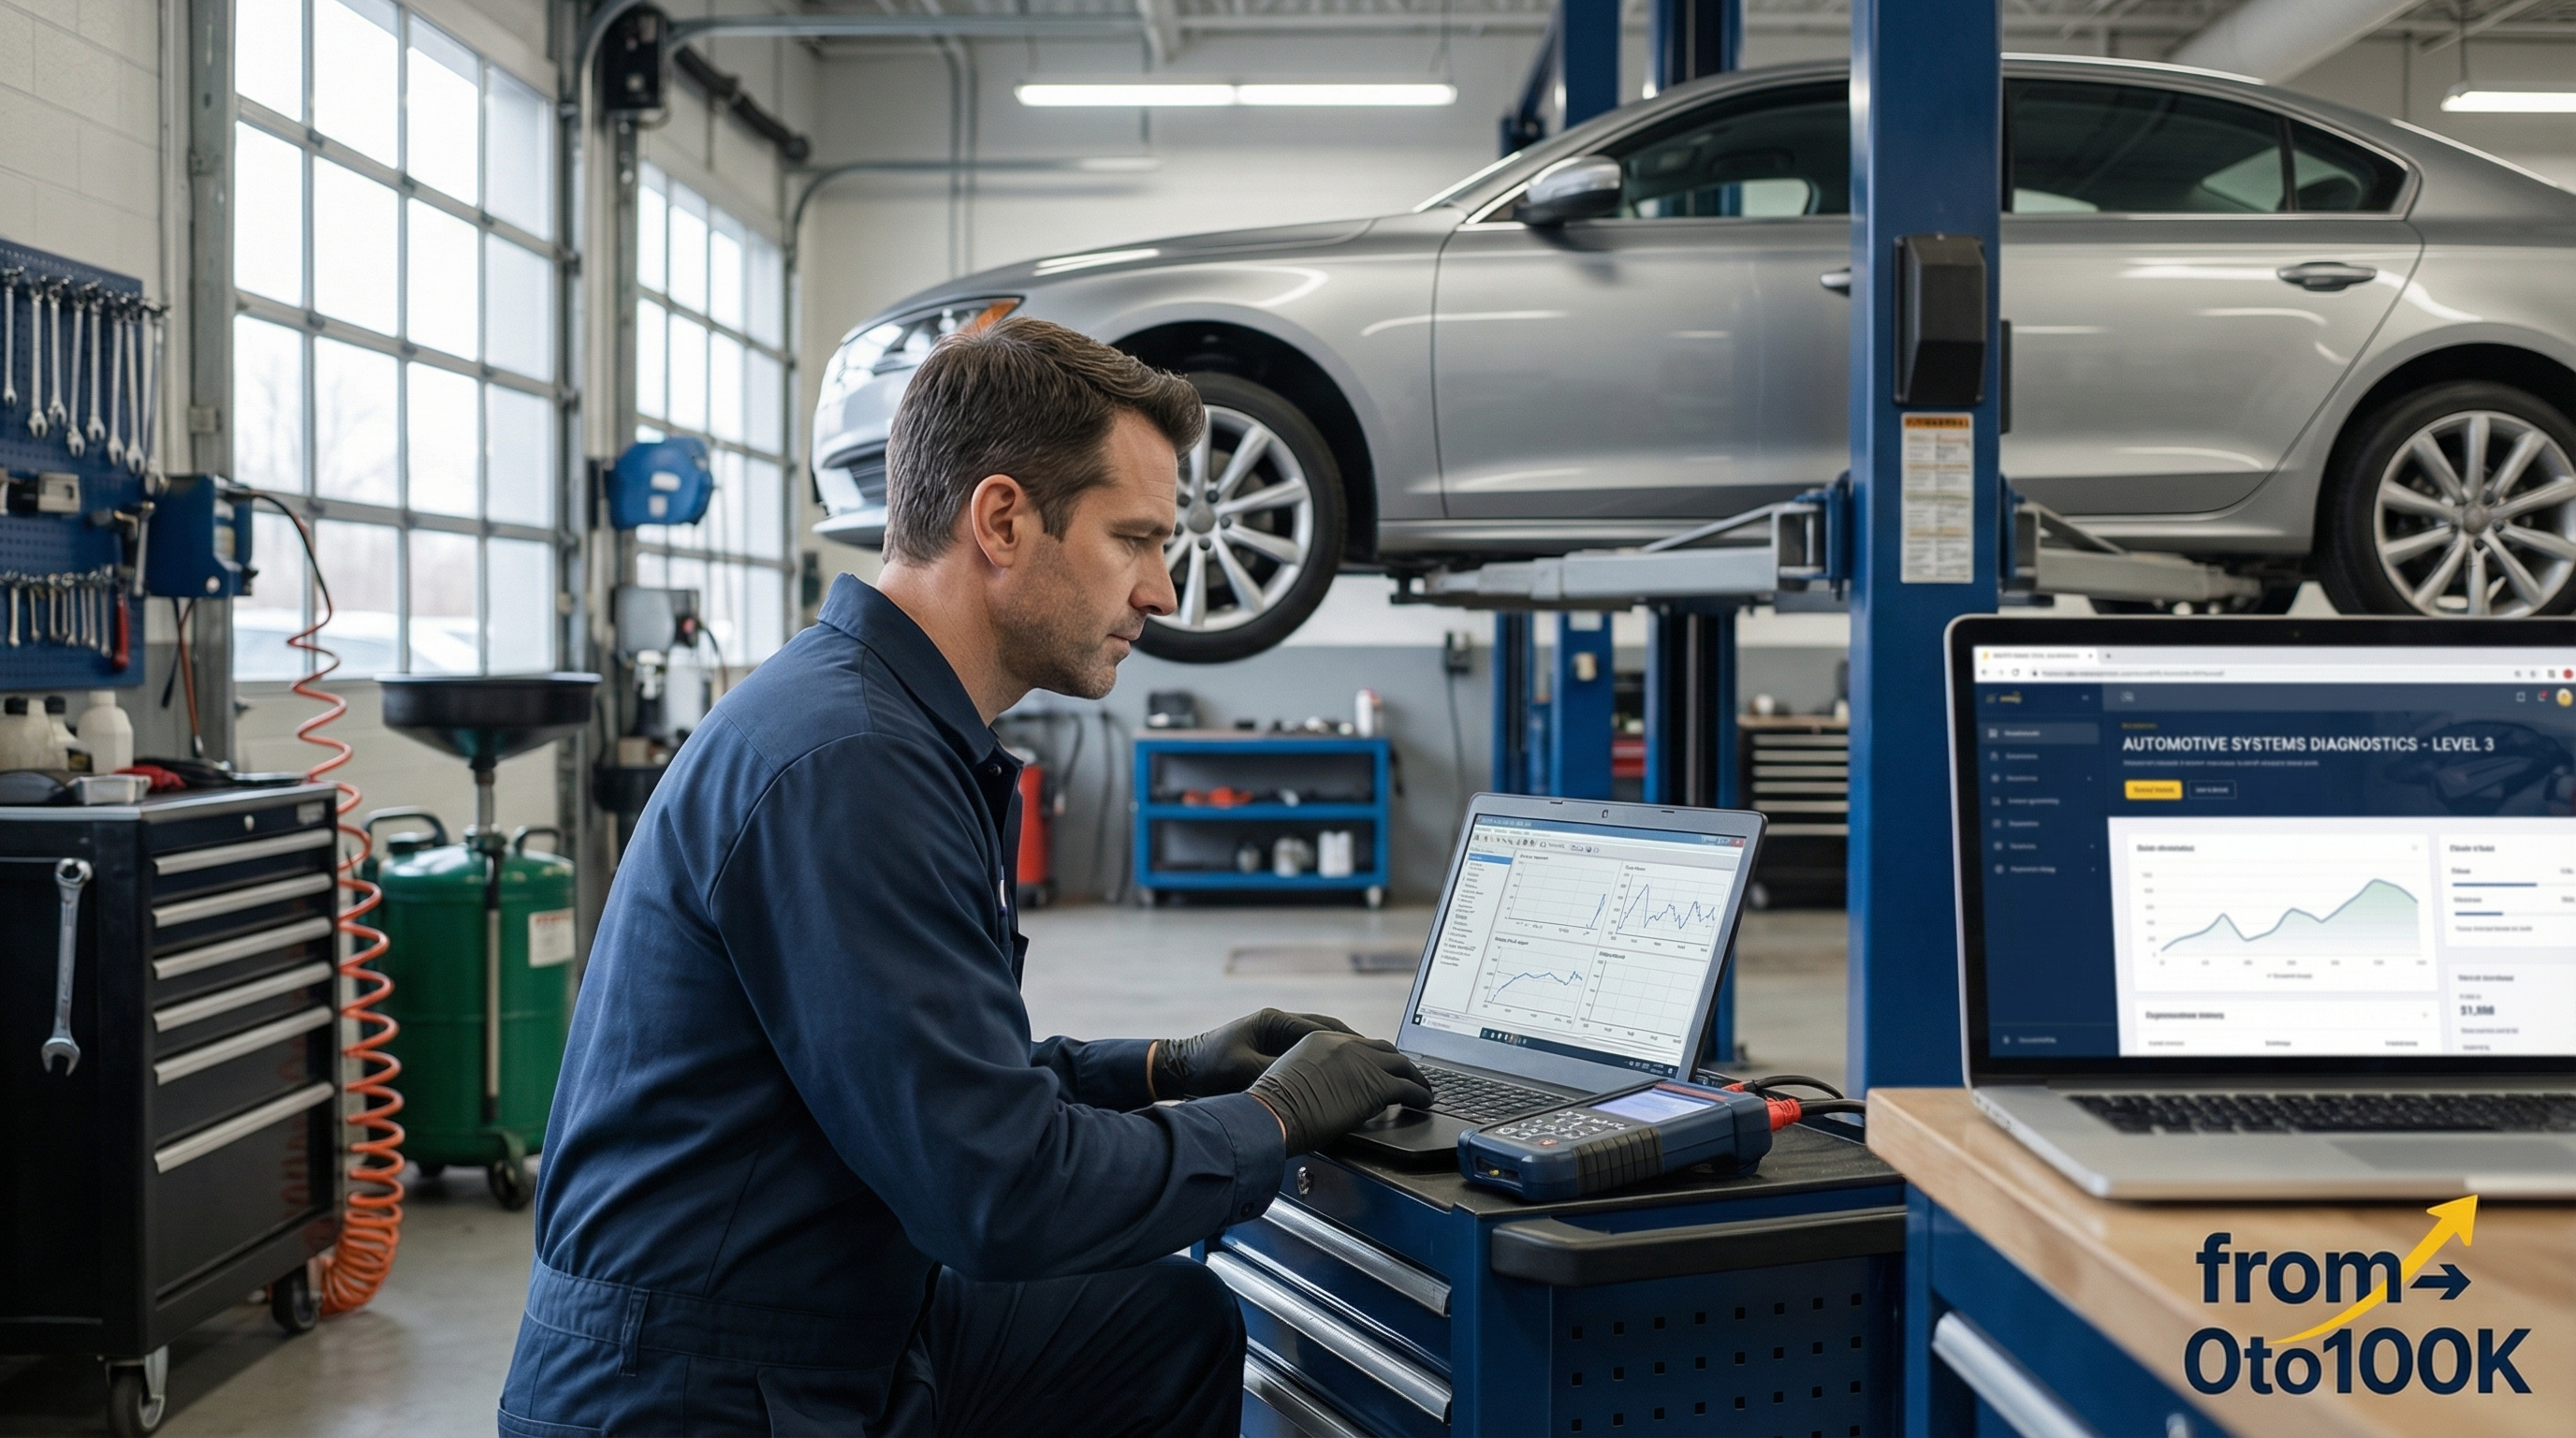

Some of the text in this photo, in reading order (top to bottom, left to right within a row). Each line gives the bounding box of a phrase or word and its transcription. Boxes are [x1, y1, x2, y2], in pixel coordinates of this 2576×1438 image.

[2122, 736, 2228, 752] AUTOMOTIVE
[2232, 736, 2306, 752] SYSTEMS
[2310, 736, 2418, 752] DIAGNOSTICS
[2432, 736, 2481, 752] LEVEL
[2484, 736, 2495, 752] 3
